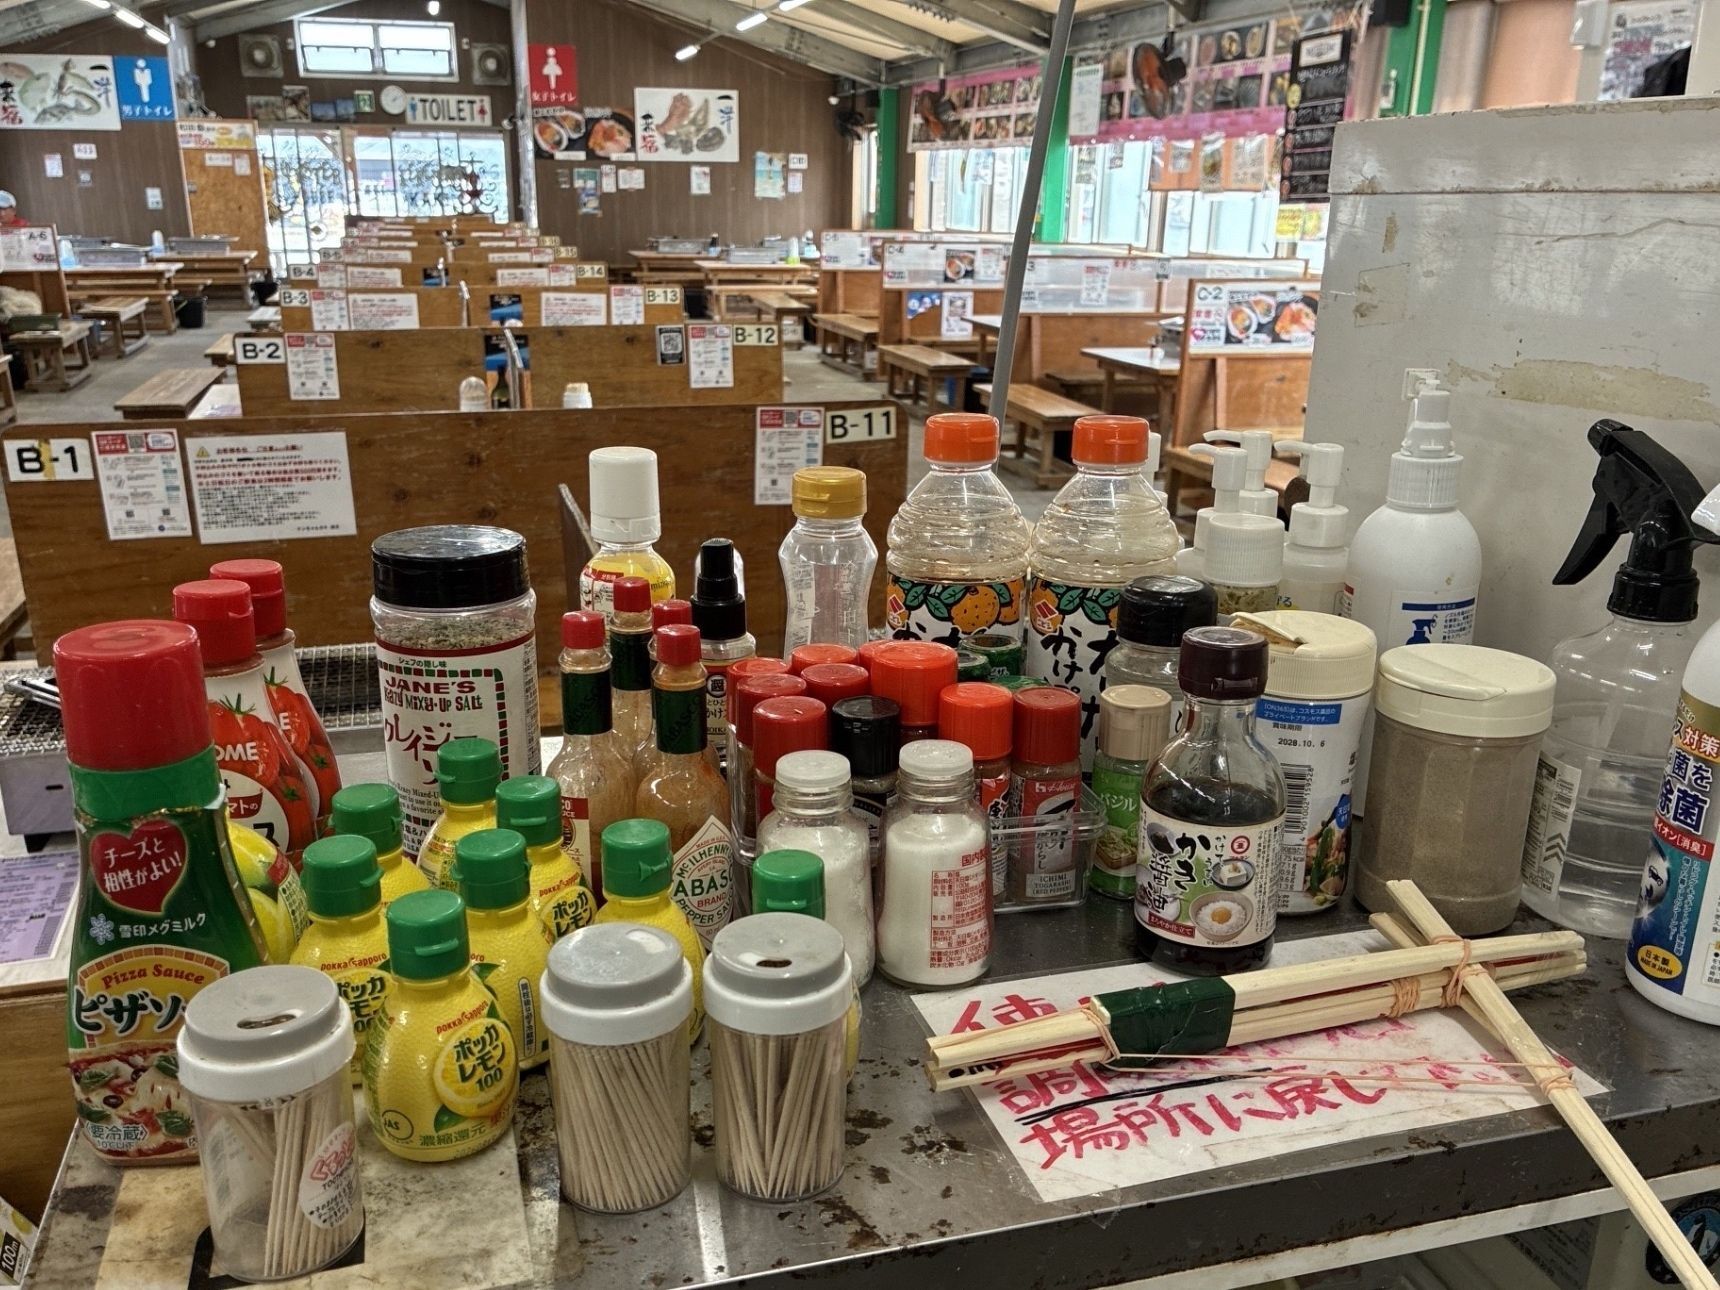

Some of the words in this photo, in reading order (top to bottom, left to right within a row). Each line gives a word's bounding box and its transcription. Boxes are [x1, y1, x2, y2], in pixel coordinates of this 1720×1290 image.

[418, 98, 476, 121] TOILET
[293, 266, 314, 277] B-4
[577, 265, 605, 276] B-14
[282, 291, 309, 306] B-3
[647, 289, 680, 303] B-13
[1196, 285, 1223, 301] C-2
[734, 327, 776, 344] B-12
[242, 342, 282, 360] B-2
[829, 410, 892, 440] B-11
[16, 445, 80, 474] B-1
[399, 657, 447, 669] シェフの隠し味
[385, 676, 477, 695] JANE'S
[411, 803, 437, 815] favorite
[1100, 792, 1137, 812] バジル
[104, 837, 166, 868] チーズと
[103, 850, 183, 894] 相性がよい!
[1040, 874, 1067, 883] ICHIMI
[553, 891, 590, 921] ポッカ
[676, 898, 715, 924] PEPPER
[118, 912, 206, 939] 雪印メグミルク
[555, 906, 593, 938] レモン
[1645, 949, 1671, 967] 日本製
[101, 966, 148, 991] Pizza
[152, 963, 206, 986] Sauce
[1656, 964, 1673, 976] JAPAN
[453, 1024, 500, 1063] ポッカ
[457, 1042, 507, 1084] レモン
[475, 1066, 504, 1093] 100
[418, 1122, 487, 1148] 濃縮還元
